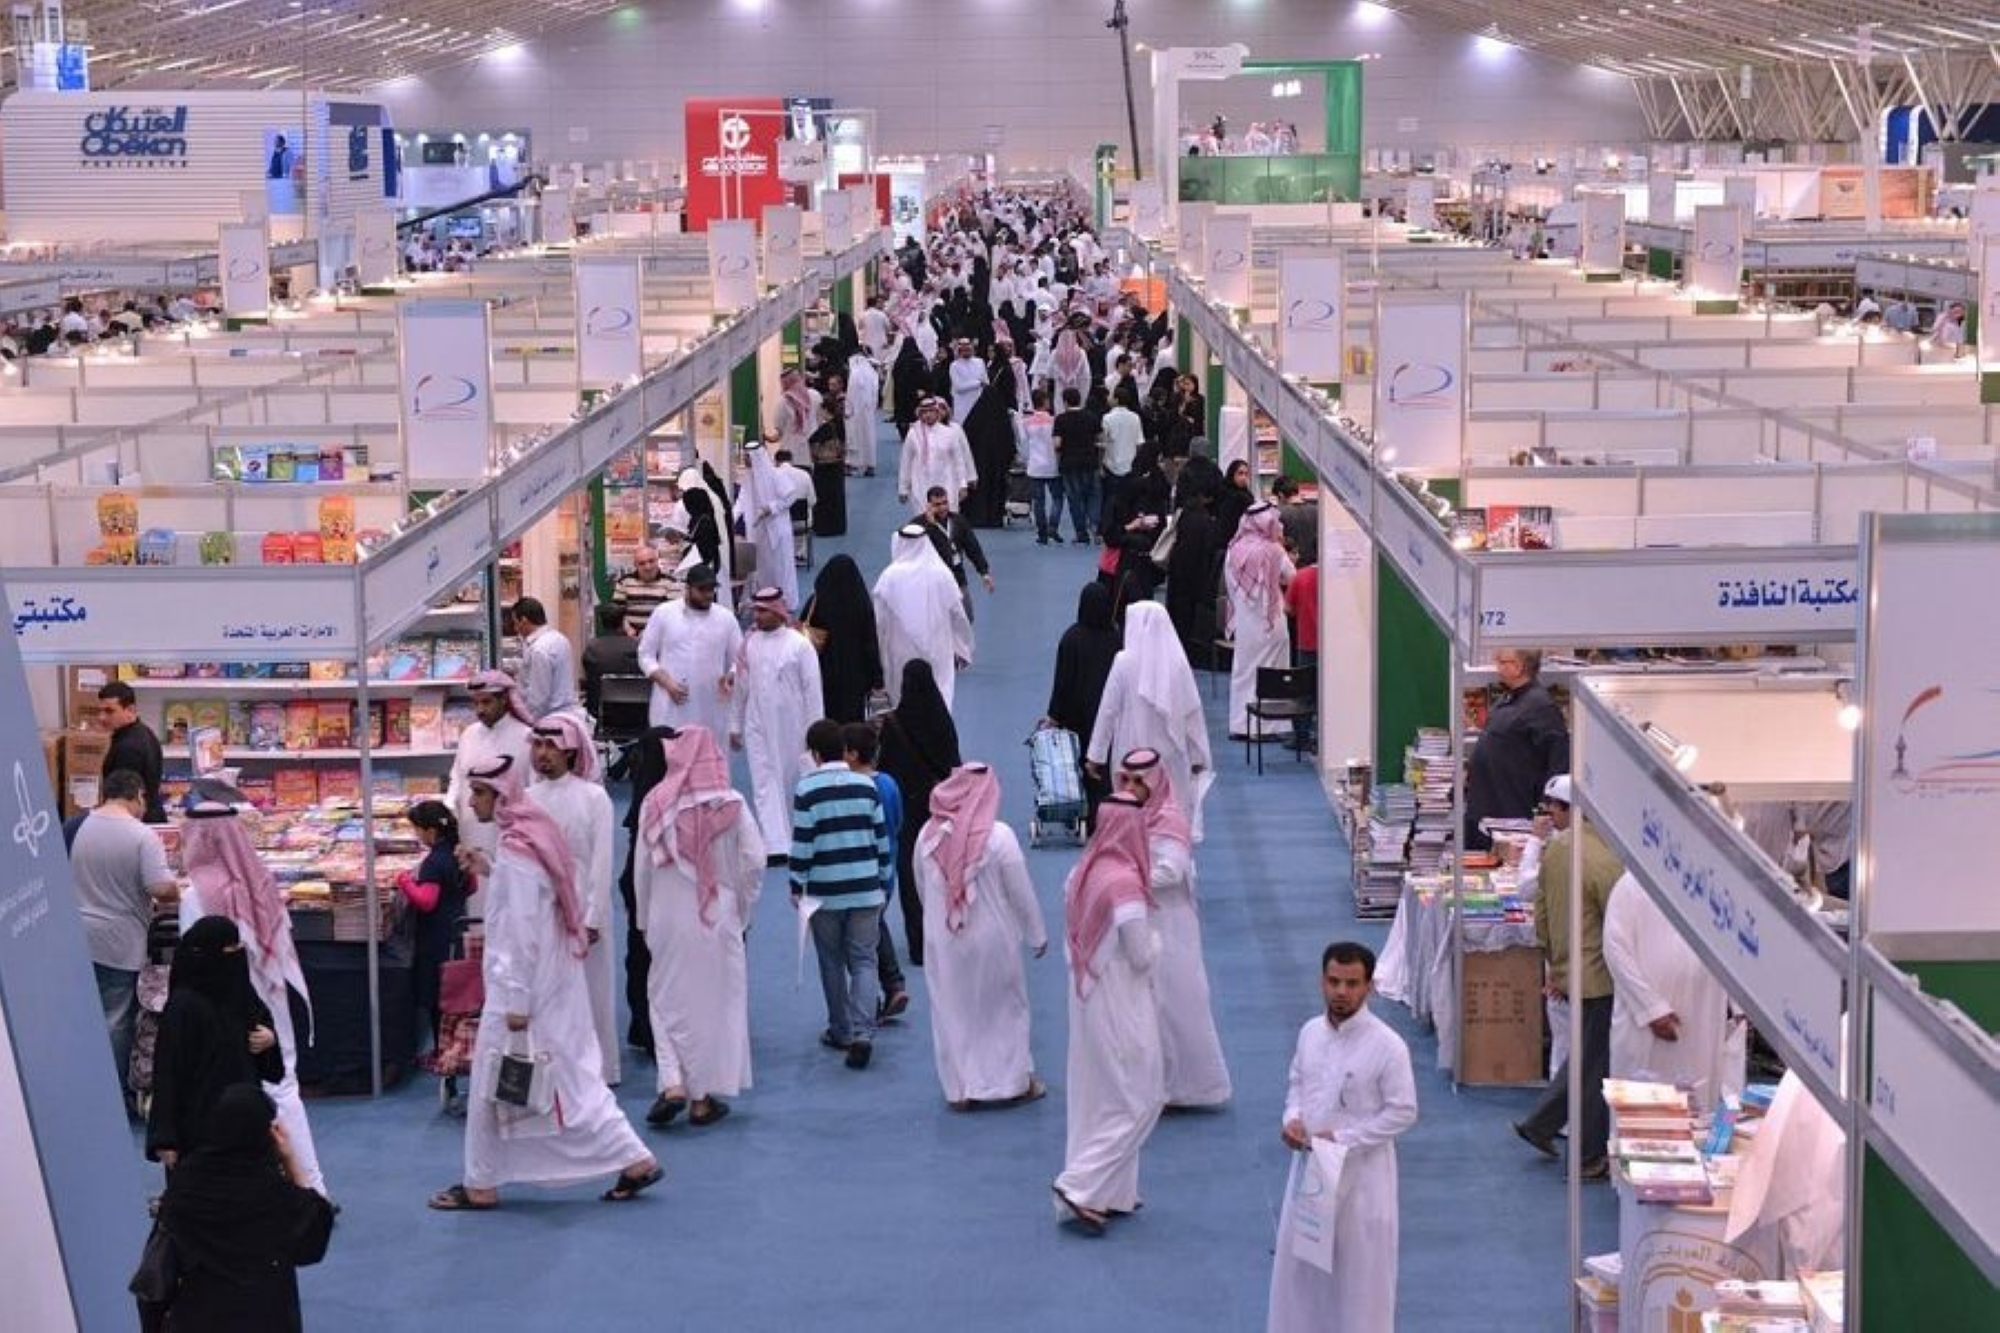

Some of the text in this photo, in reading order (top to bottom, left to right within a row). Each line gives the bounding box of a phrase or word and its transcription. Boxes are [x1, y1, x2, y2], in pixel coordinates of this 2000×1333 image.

[1718, 580, 1796, 607] النافذة
[13, 597, 86, 635] مكتبتي
[222, 623, 259, 640] المتحدة
[260, 623, 298, 641] العربية
